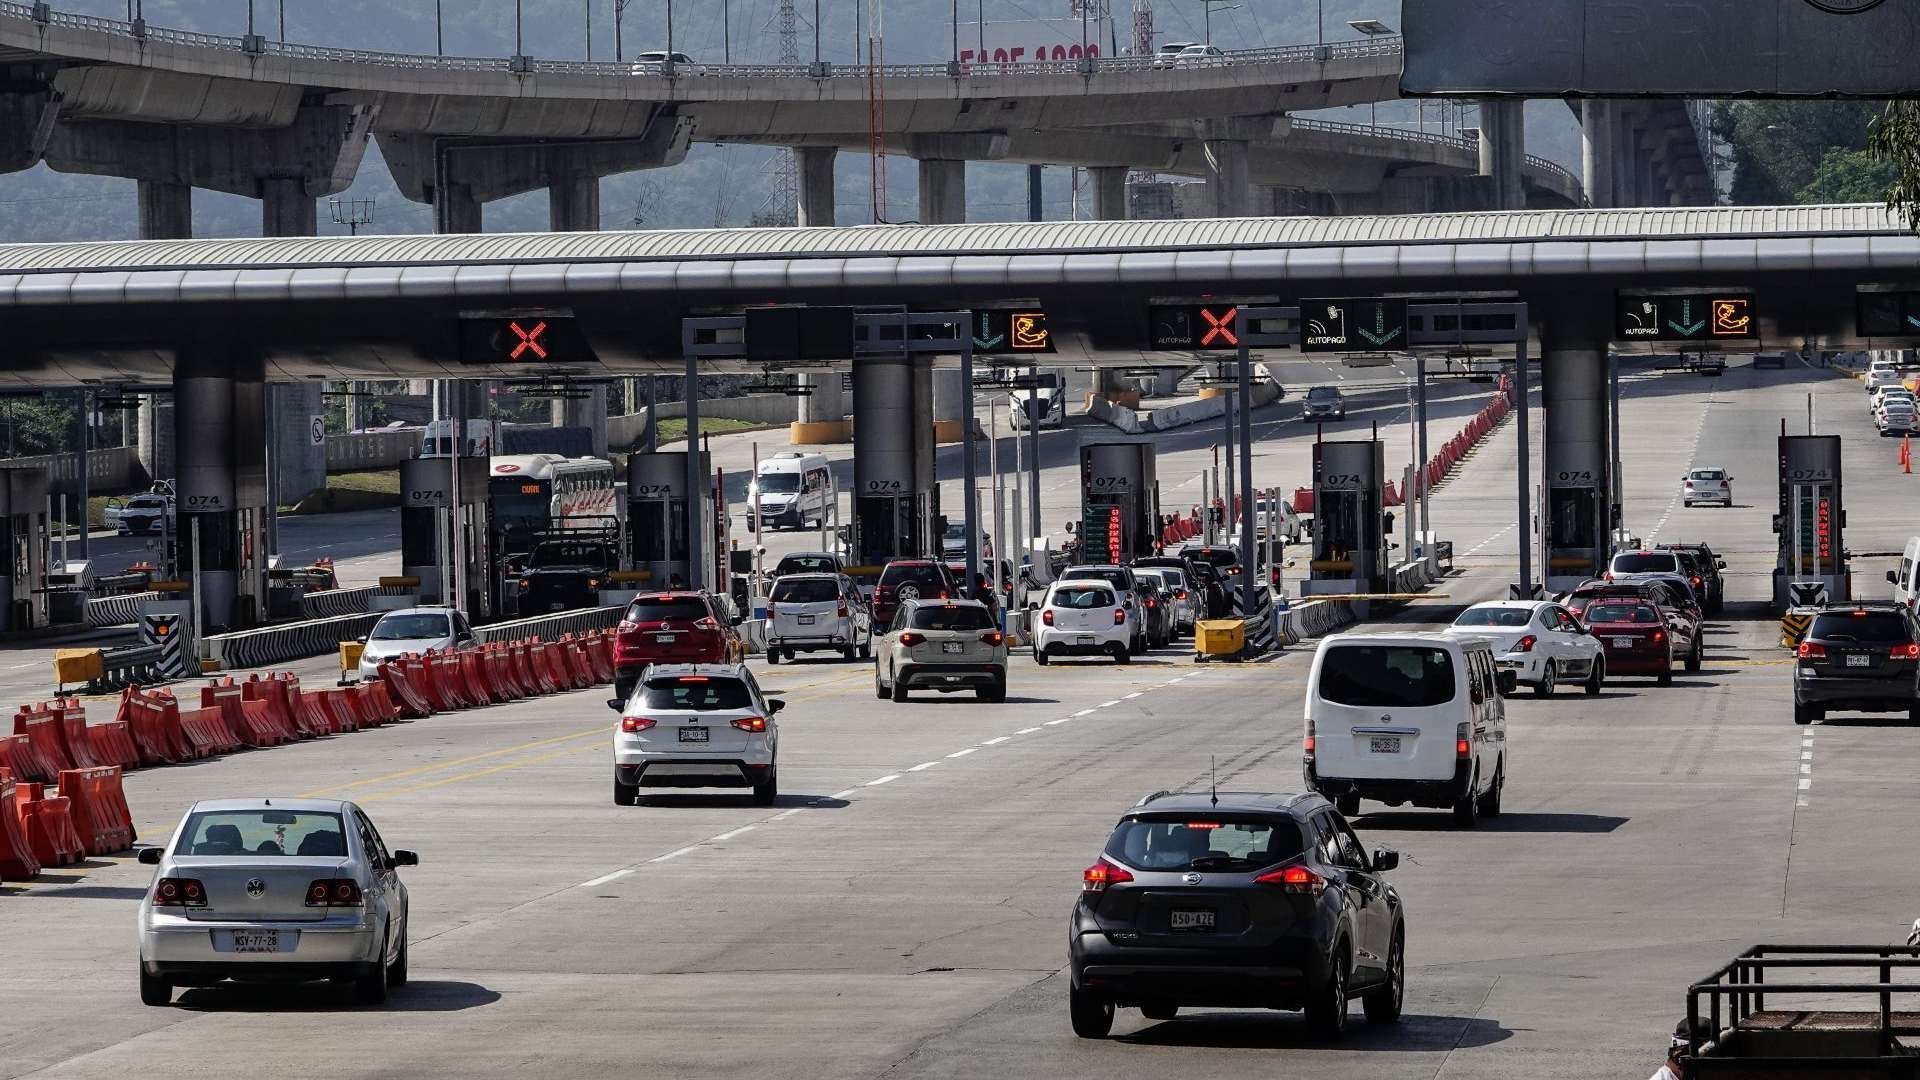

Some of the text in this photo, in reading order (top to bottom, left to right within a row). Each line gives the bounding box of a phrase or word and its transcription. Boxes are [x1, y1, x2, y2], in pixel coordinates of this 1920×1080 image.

[1625, 327, 1660, 336] AUTOPAGO
[1158, 336, 1192, 344] AUTOPAGO
[1307, 336, 1347, 345] AUTOPAGO
[1328, 474, 1360, 484] 074
[1559, 471, 1592, 481] 074
[870, 480, 901, 490] 074
[1095, 476, 1129, 487] 074
[640, 484, 671, 495] 074
[188, 495, 220, 505] 074
[412, 490, 443, 500] 074
